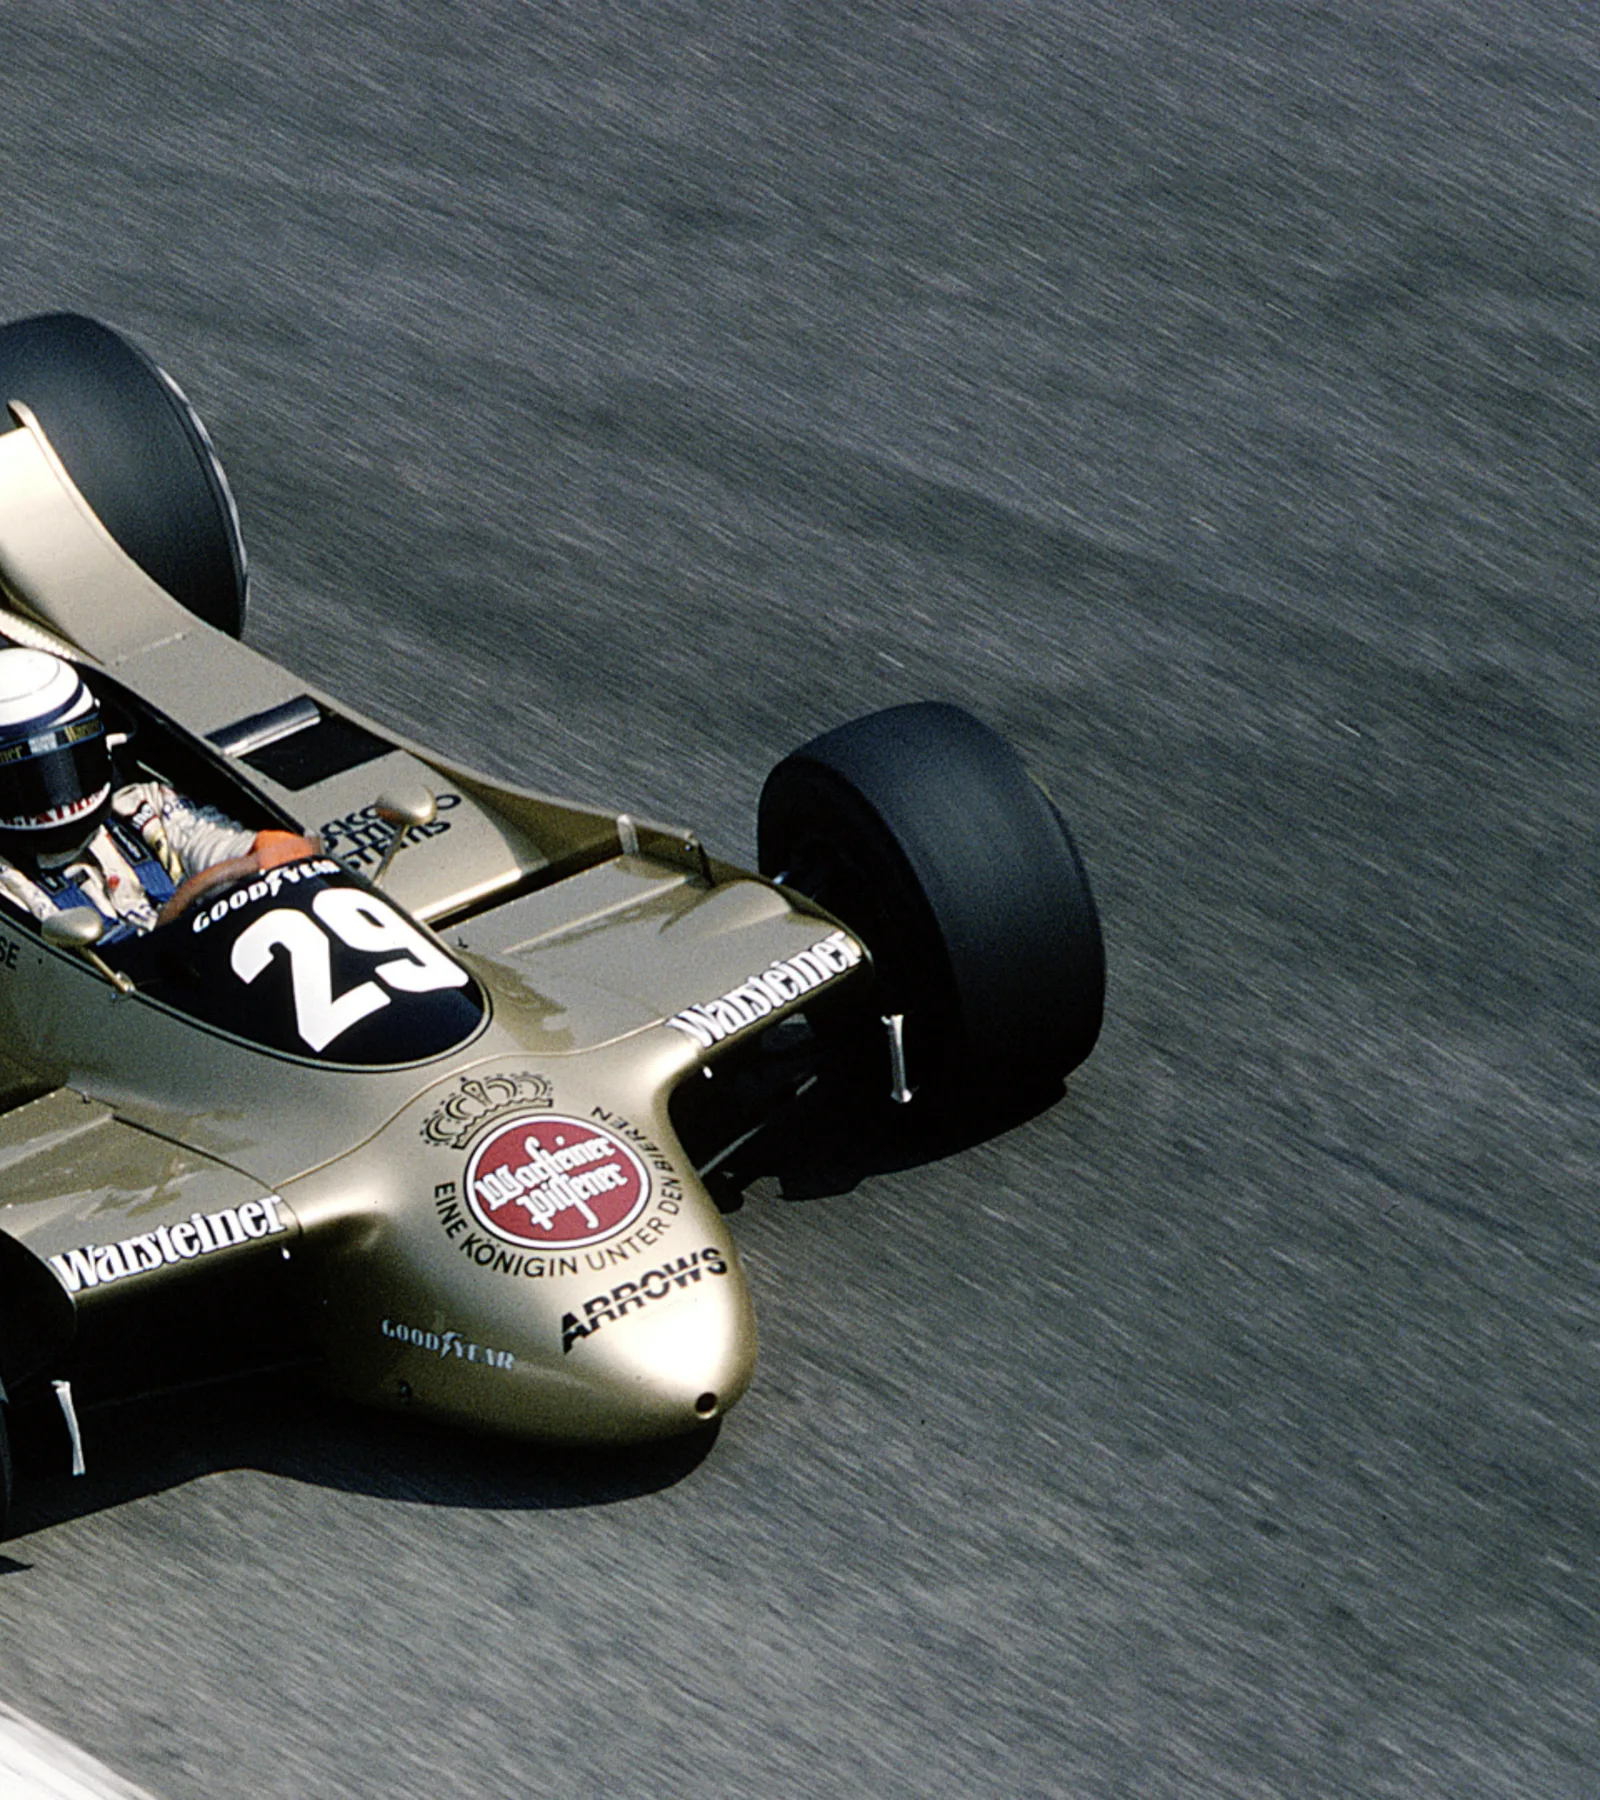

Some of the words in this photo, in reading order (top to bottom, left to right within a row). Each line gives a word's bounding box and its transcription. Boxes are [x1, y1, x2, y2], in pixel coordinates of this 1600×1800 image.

[231, 888, 469, 1052] 29
[665, 931, 861, 1047] Warsteiner
[591, 1106, 677, 1174] BIEREN
[435, 1182, 467, 1239] EINE
[657, 1177, 683, 1215] DEN
[50, 1195, 288, 1292] Warsteiner
[460, 1232, 578, 1277] KÖNIGIN
[585, 1216, 671, 1271] UNTER
[562, 1248, 728, 1354] ARROWS
[381, 1319, 516, 1370] GOODYEAR
